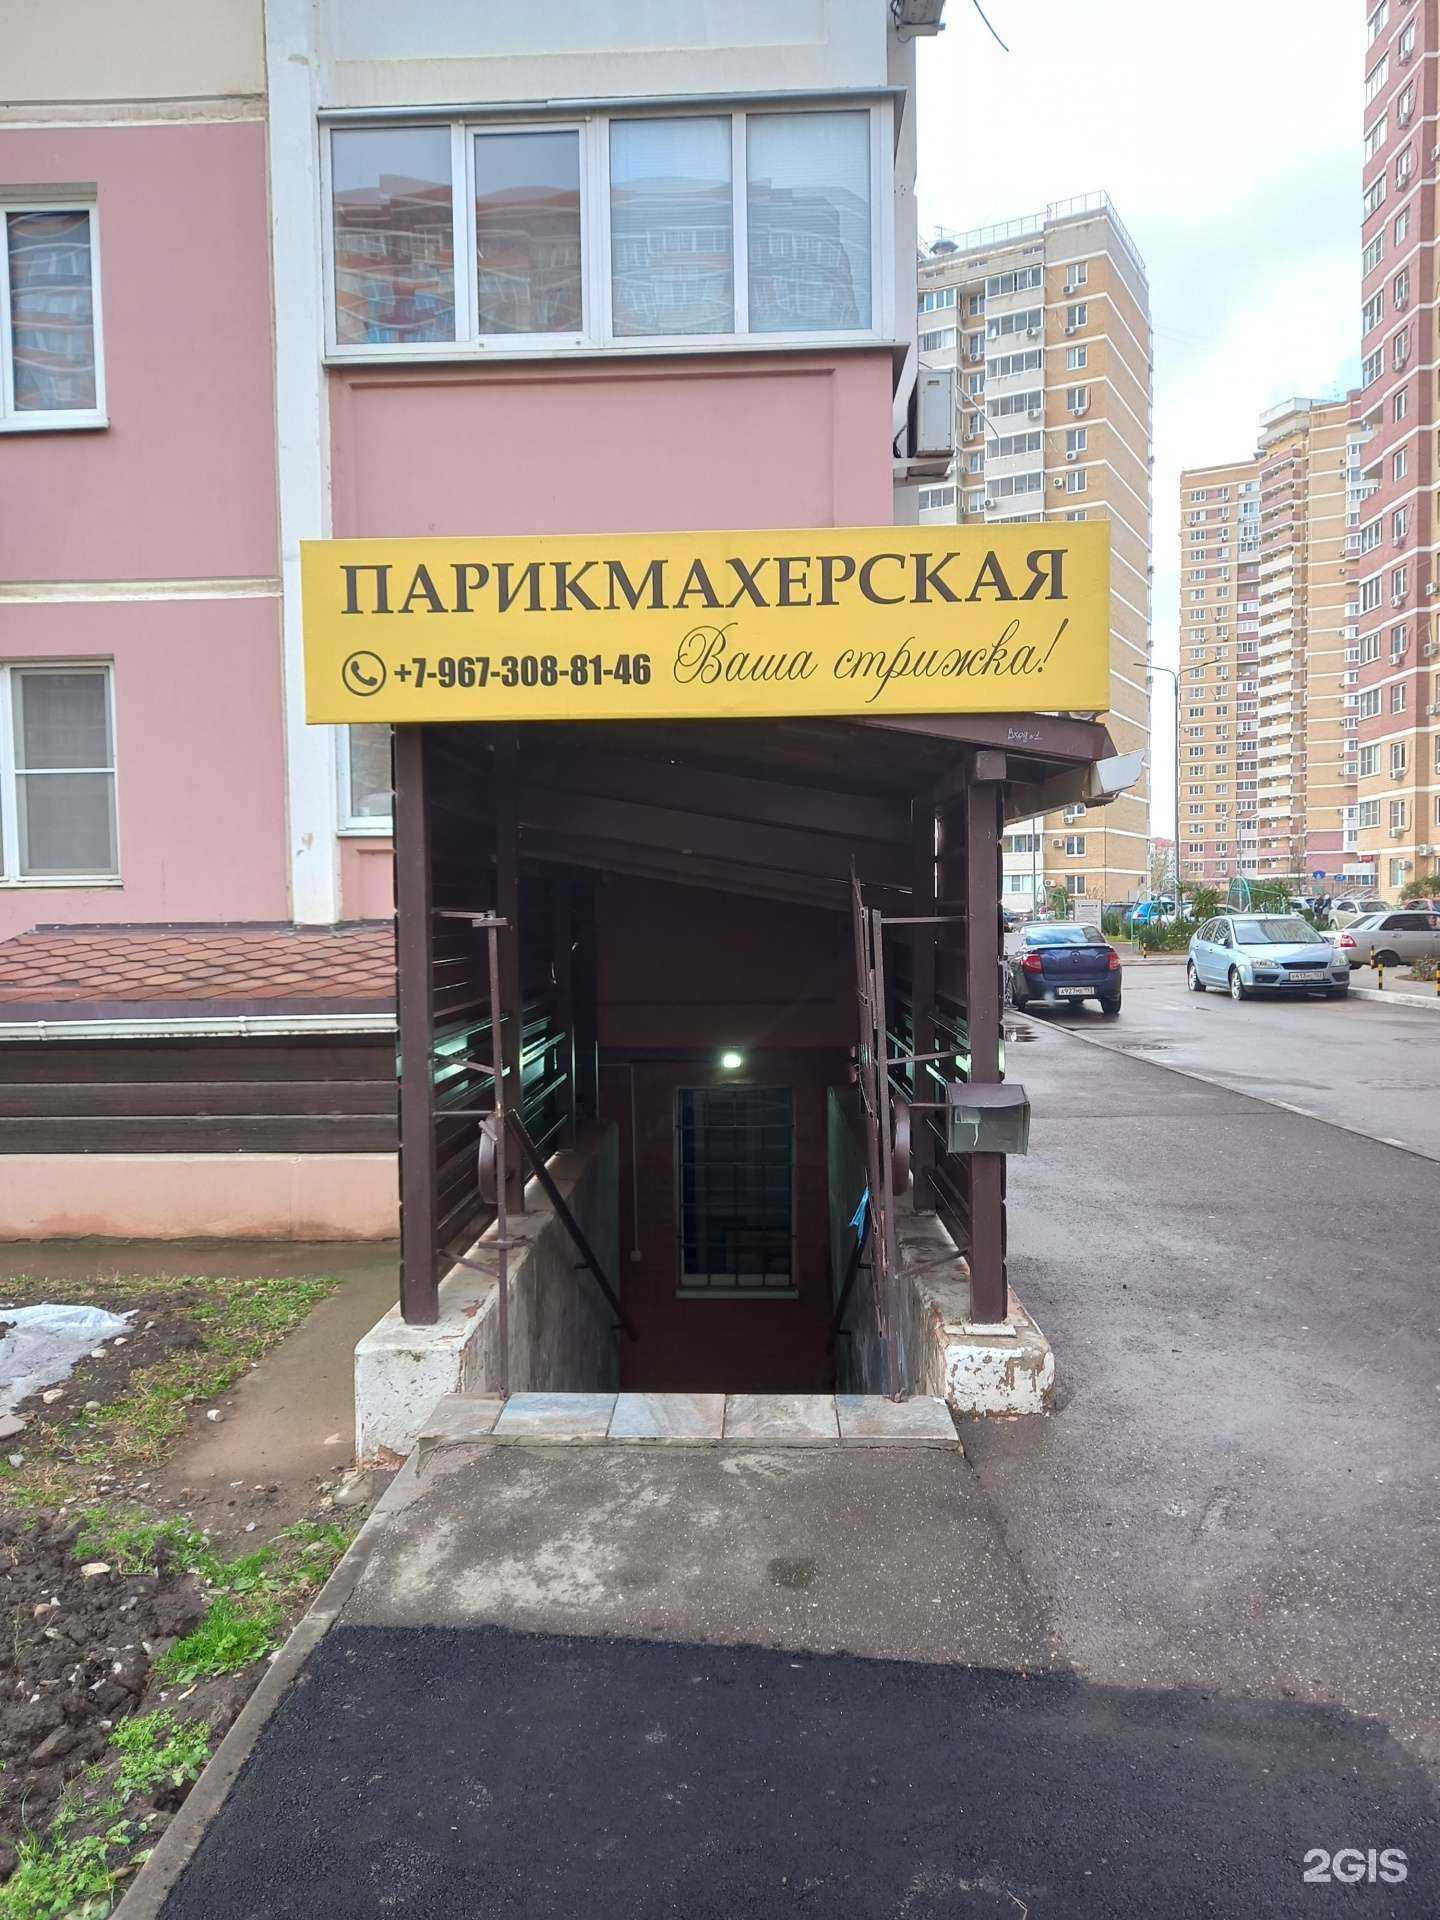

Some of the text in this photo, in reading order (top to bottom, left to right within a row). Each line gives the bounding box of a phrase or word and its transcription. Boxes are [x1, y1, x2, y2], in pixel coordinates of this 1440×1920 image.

[340, 548, 1069, 614] ПАРИКМАХЕРСКАЯ
[394, 653, 651, 689] +7-967-308-81-46
[673, 617, 1070, 704] Ваша стрижка!
